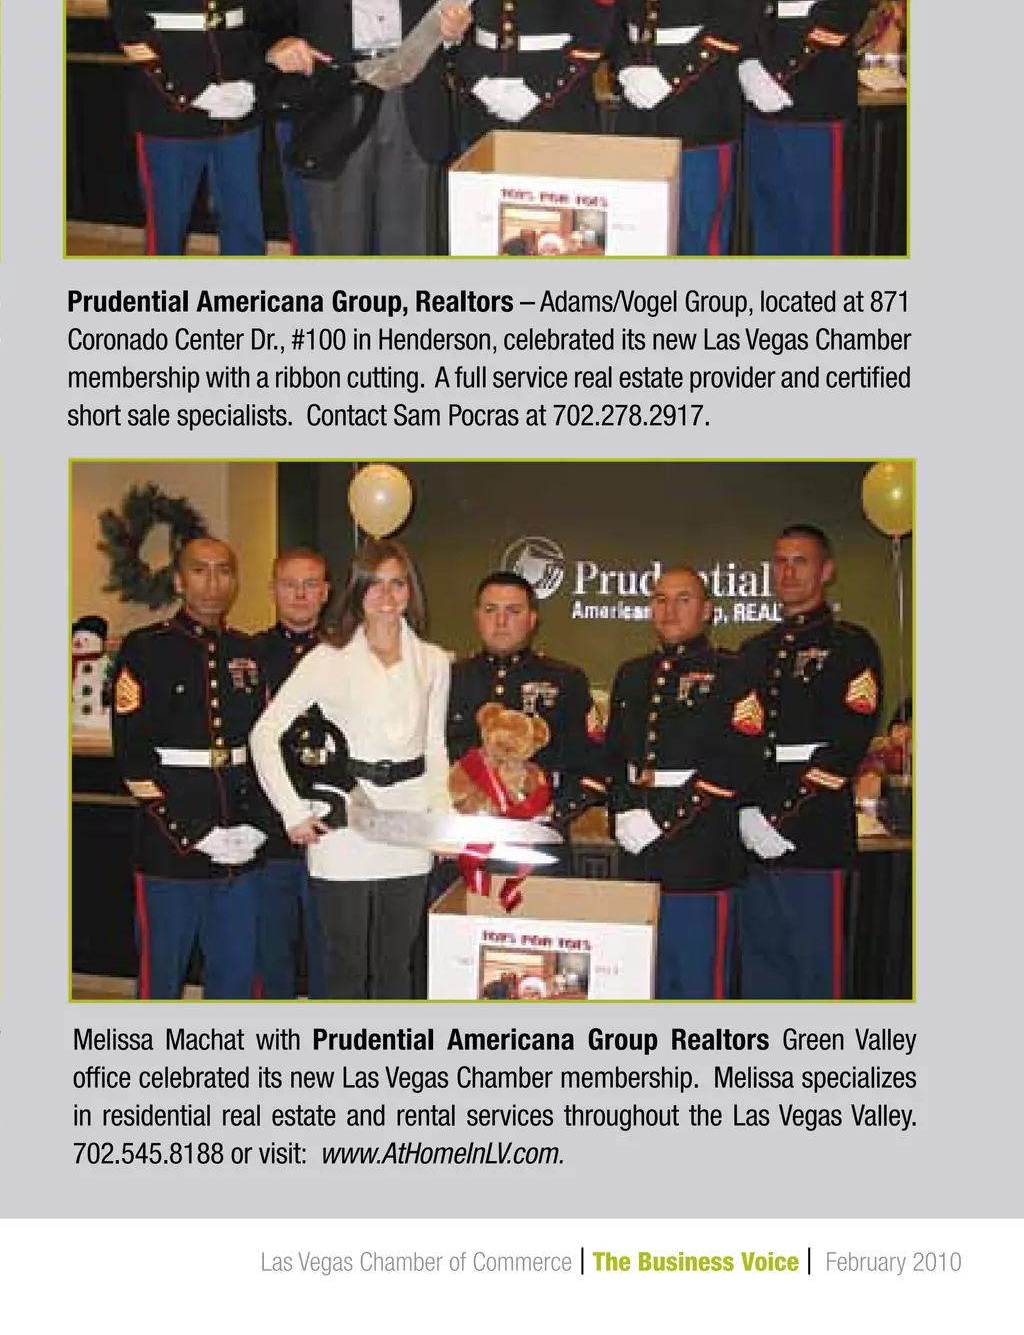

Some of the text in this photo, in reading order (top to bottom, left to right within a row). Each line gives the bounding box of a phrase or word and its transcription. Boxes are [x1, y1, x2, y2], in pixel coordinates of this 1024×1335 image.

[69, 366, 910, 393] membership with a ribbon cutting. A full service real estate provider and certified
[68, 404, 709, 431] short sale specialists. Contact Sam Pocras at 702.278.2917.
[574, 560, 773, 597] Prudtial
[73, 1066, 916, 1093] office celebrated its new Las Vegas Chamber membership. Melissa specializes
[74, 1142, 563, 1164] 702.545.8188 or visit: www.AtHomeInLV.com.
[262, 1251, 961, 1276] Las Vegas Chamber of Commerce The Business Voice February 2010
